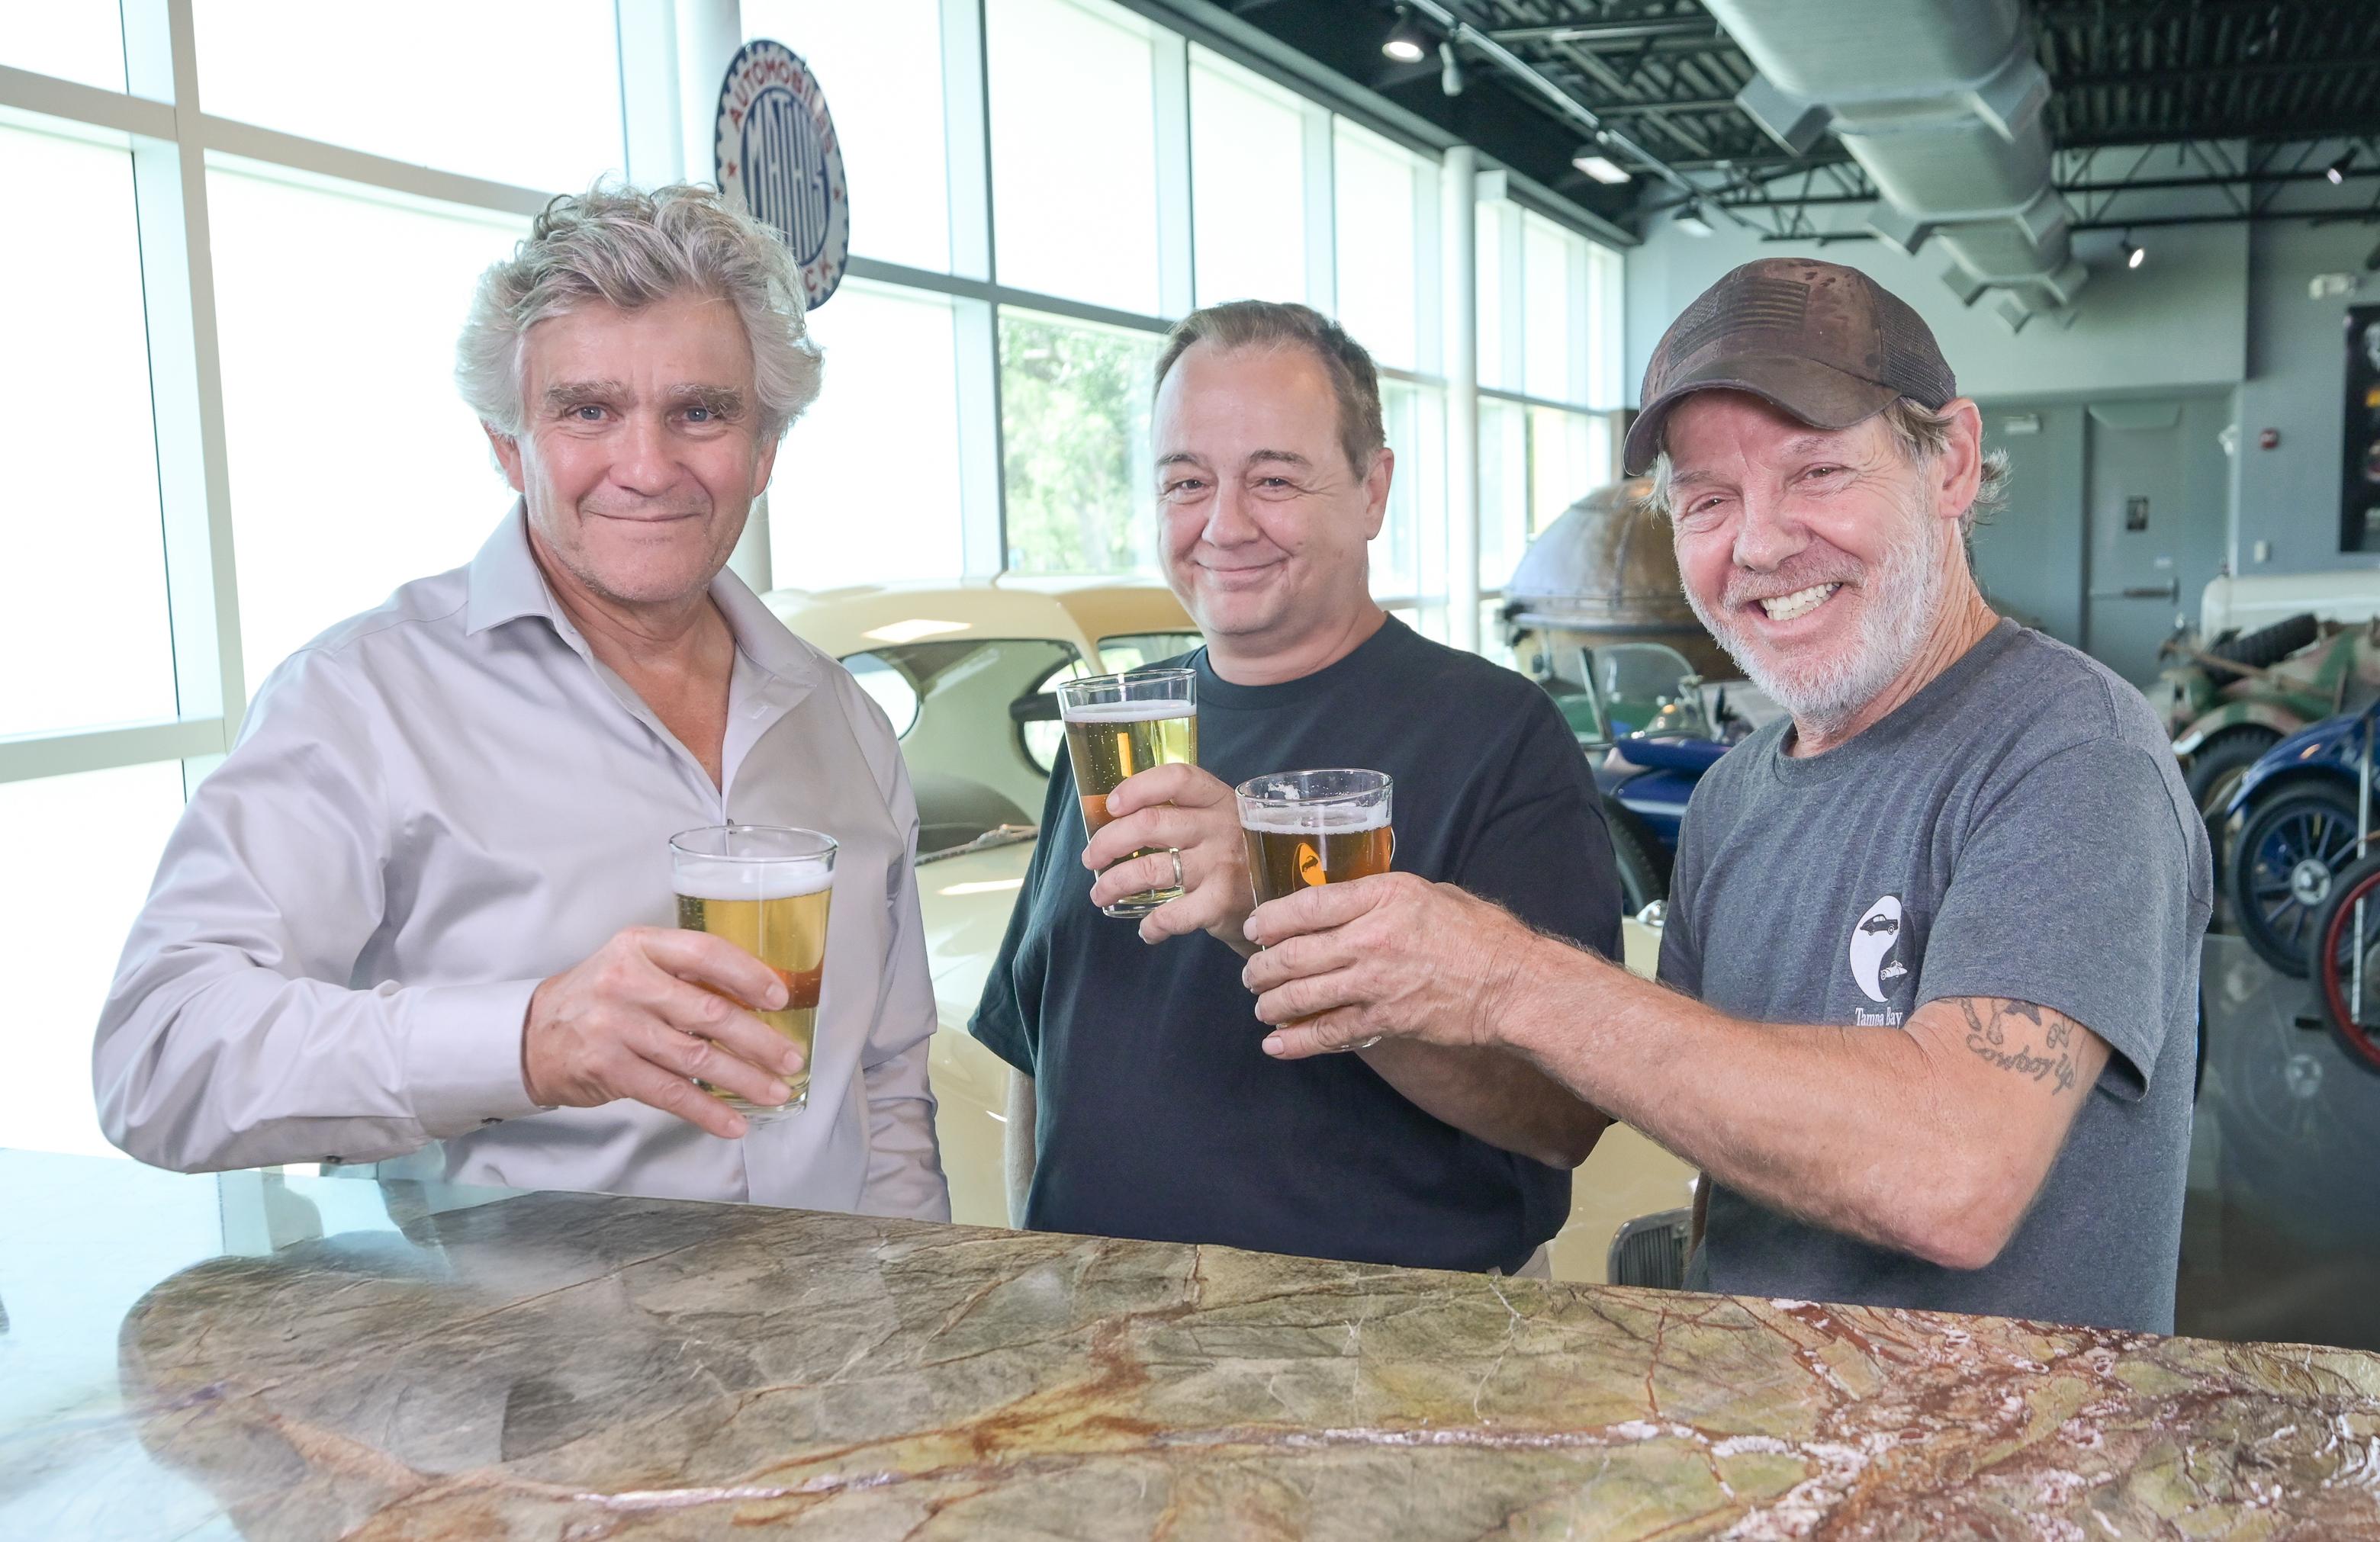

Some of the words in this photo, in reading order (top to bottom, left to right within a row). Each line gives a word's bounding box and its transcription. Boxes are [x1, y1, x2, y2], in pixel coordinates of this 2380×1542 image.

[1855, 1007, 1884, 1026] Tampa
[1886, 1007, 1903, 1030] Bay
[1966, 1033, 2056, 1081] Cowboy
